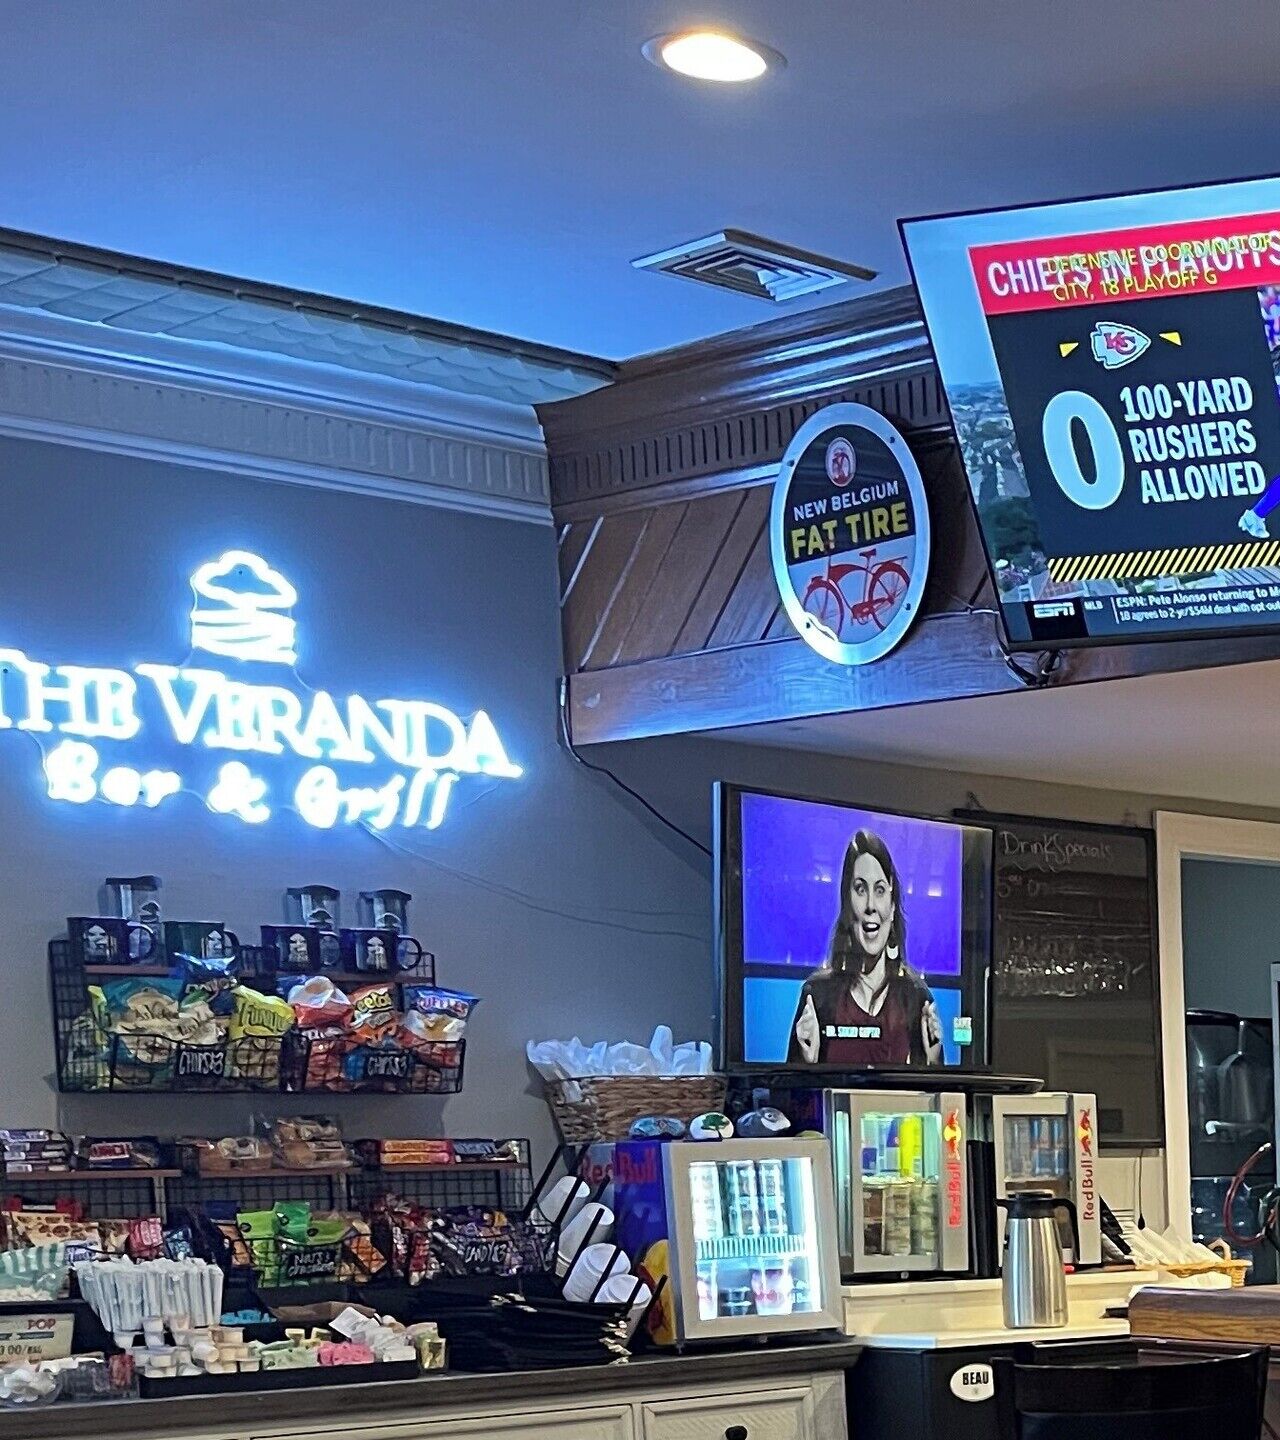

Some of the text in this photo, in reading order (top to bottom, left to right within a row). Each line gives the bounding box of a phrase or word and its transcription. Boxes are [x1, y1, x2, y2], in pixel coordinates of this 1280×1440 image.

[987, 252, 1092, 297] CHIEFS
[1100, 279, 1120, 297] 18
[1124, 270, 1200, 293] PLAYOFF
[1203, 267, 1218, 286] G
[1119, 376, 1253, 423] 100-YARD
[1042, 389, 1126, 511] 0
[1127, 418, 1257, 463] RUSHERS
[793, 480, 900, 522] NEW BELGIUM
[1140, 460, 1267, 504] ALLOWED
[791, 501, 910, 559] FAT TIRE
[1172, 591, 1207, 604] Alonso
[1208, 588, 1255, 602] returning
[1256, 588, 1268, 599] to
[1213, 604, 1232, 615] deal
[1233, 602, 1250, 613] with
[135, 663, 524, 779] VERANDA
[46, 739, 182, 808] Bar
[207, 761, 270, 824] &
[1080, 1159, 1095, 1221] Red Bull
[962, 1370, 990, 1385] BEAU
